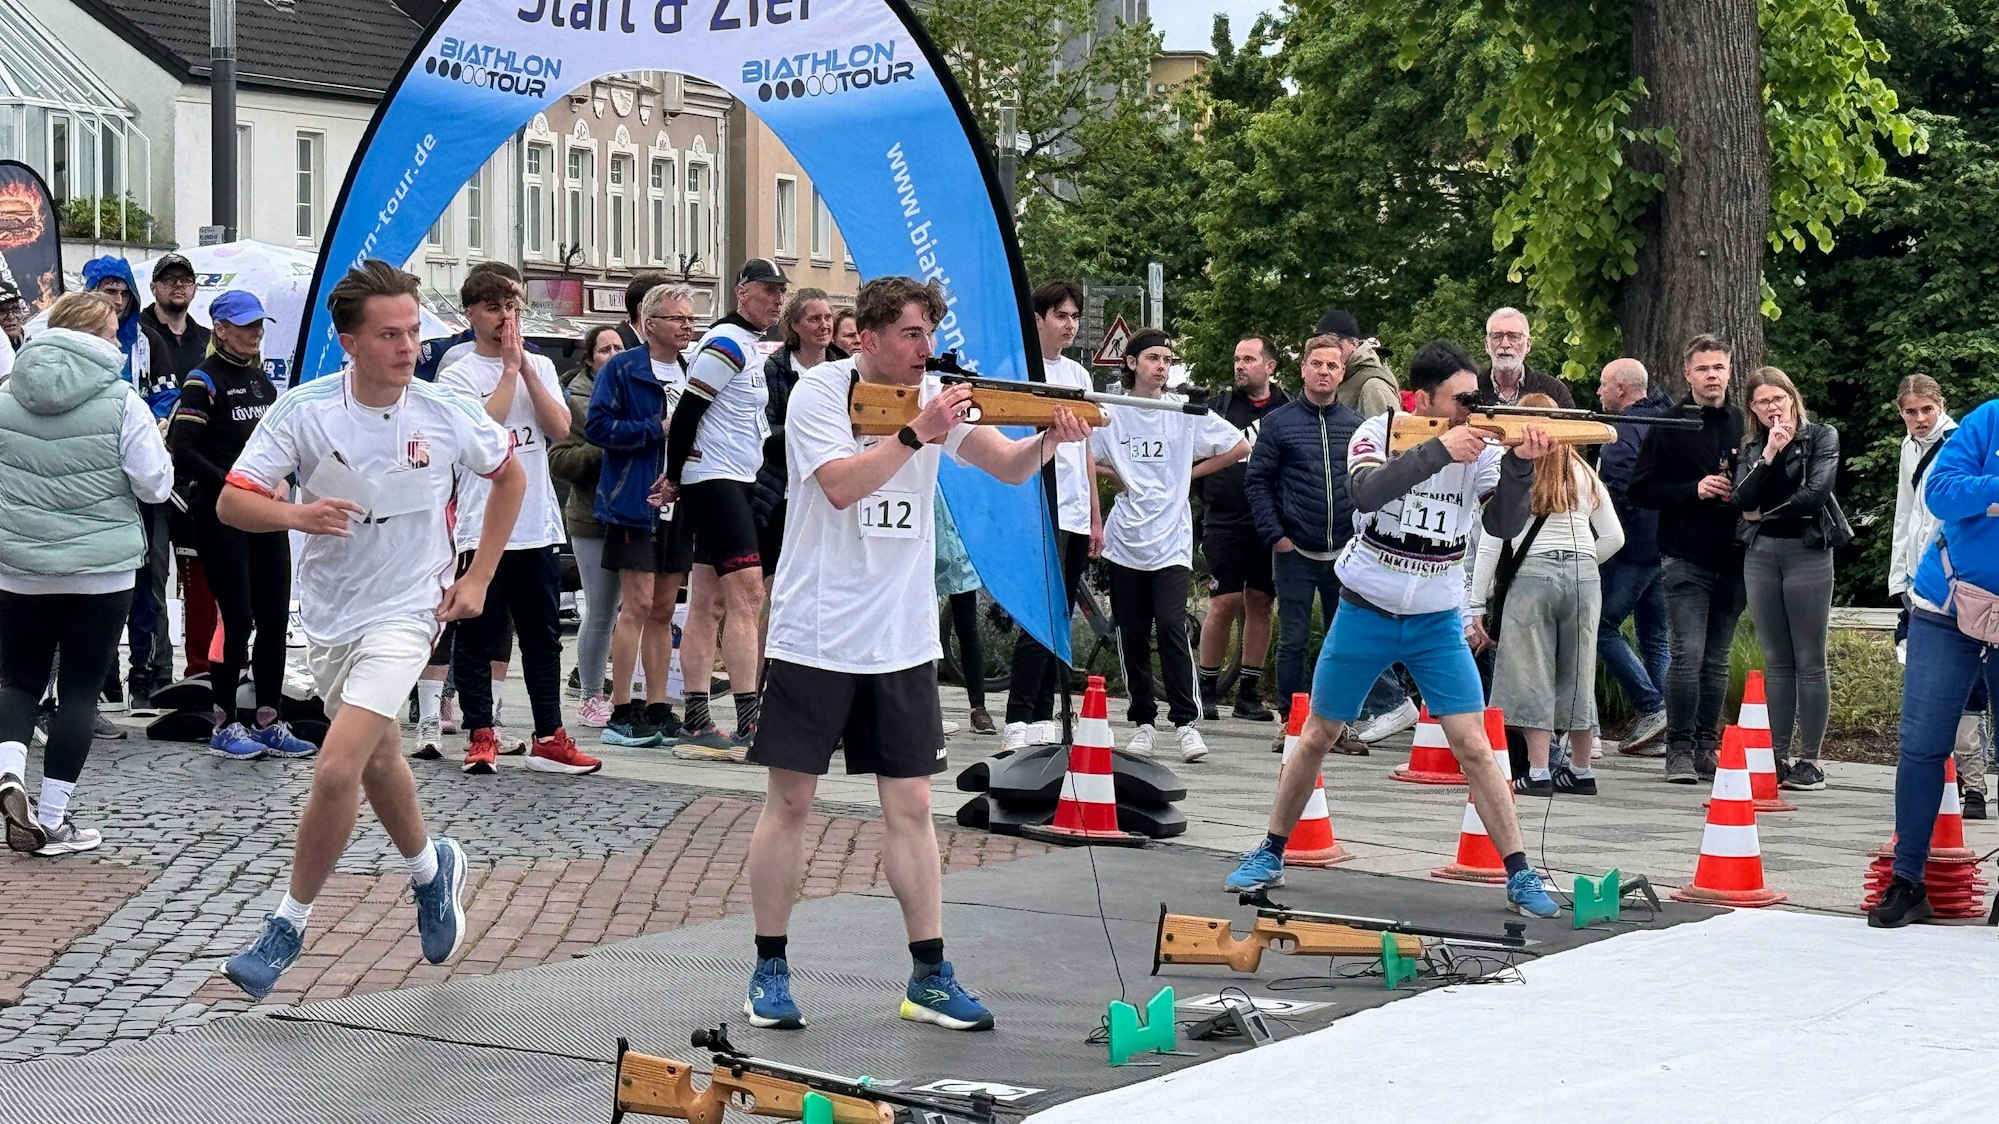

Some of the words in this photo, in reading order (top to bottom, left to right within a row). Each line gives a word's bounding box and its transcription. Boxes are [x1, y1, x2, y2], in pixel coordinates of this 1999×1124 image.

[440, 36, 562, 80] BIATHLON
[742, 39, 896, 84] BIATHLON
[487, 70, 547, 99] TOUR
[836, 61, 915, 92] TOUR
[511, 426, 535, 449] 12
[862, 500, 912, 529] 112
[1402, 506, 1448, 535] 111
